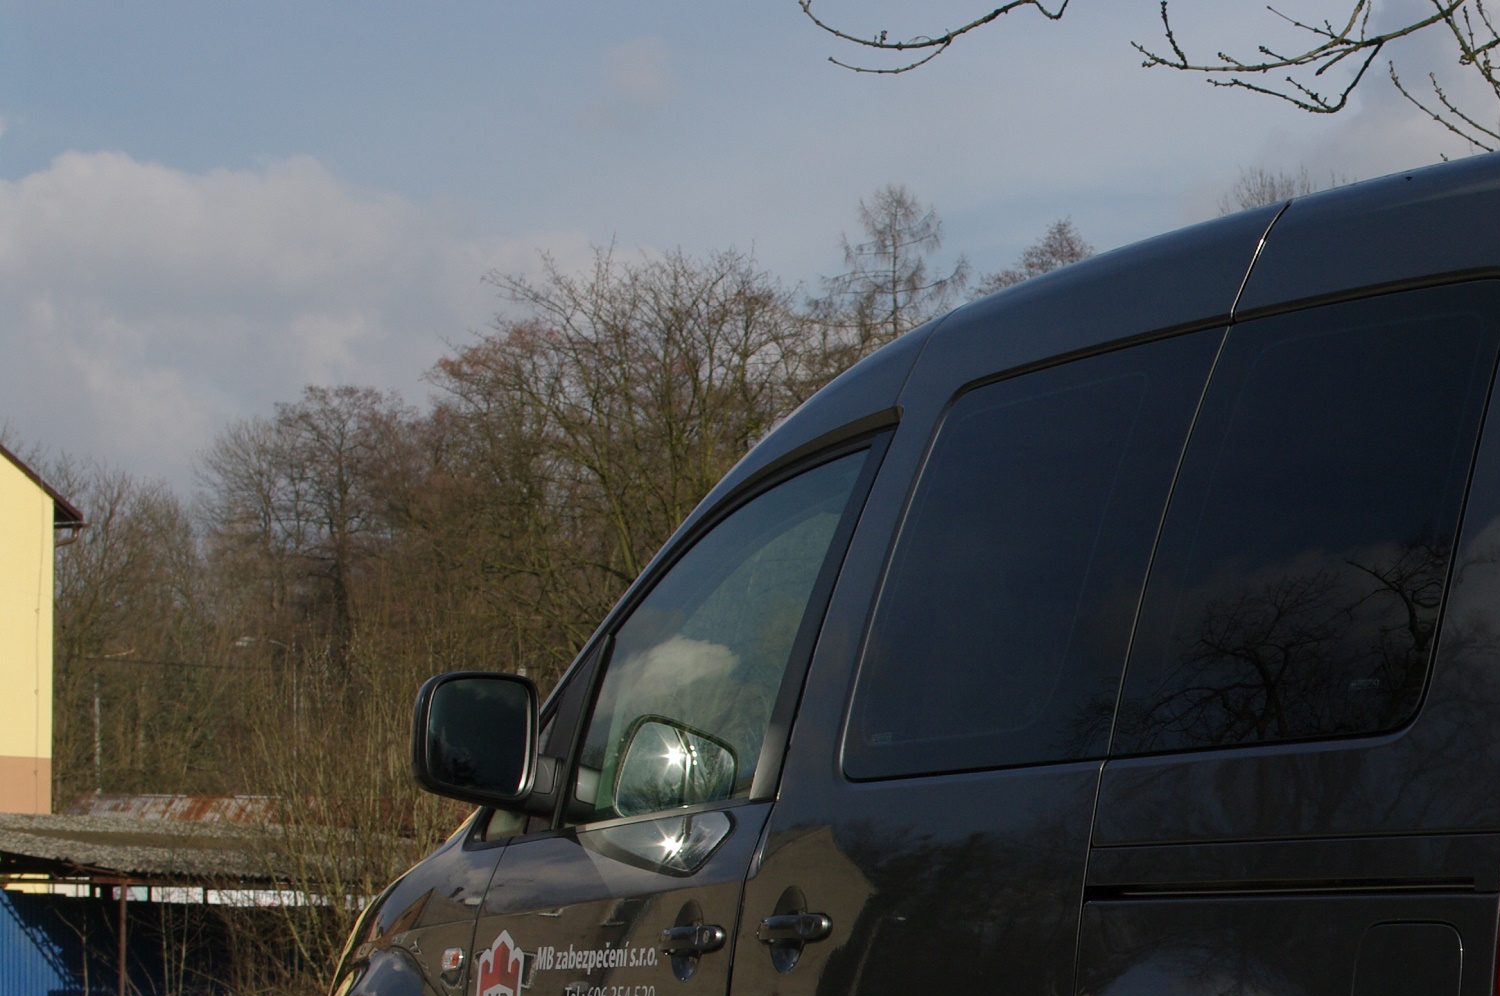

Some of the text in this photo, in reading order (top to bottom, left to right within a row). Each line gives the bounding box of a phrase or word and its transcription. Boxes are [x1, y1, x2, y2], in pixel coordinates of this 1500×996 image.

[536, 941, 658, 975] MB zabezpečení s.r.o.
